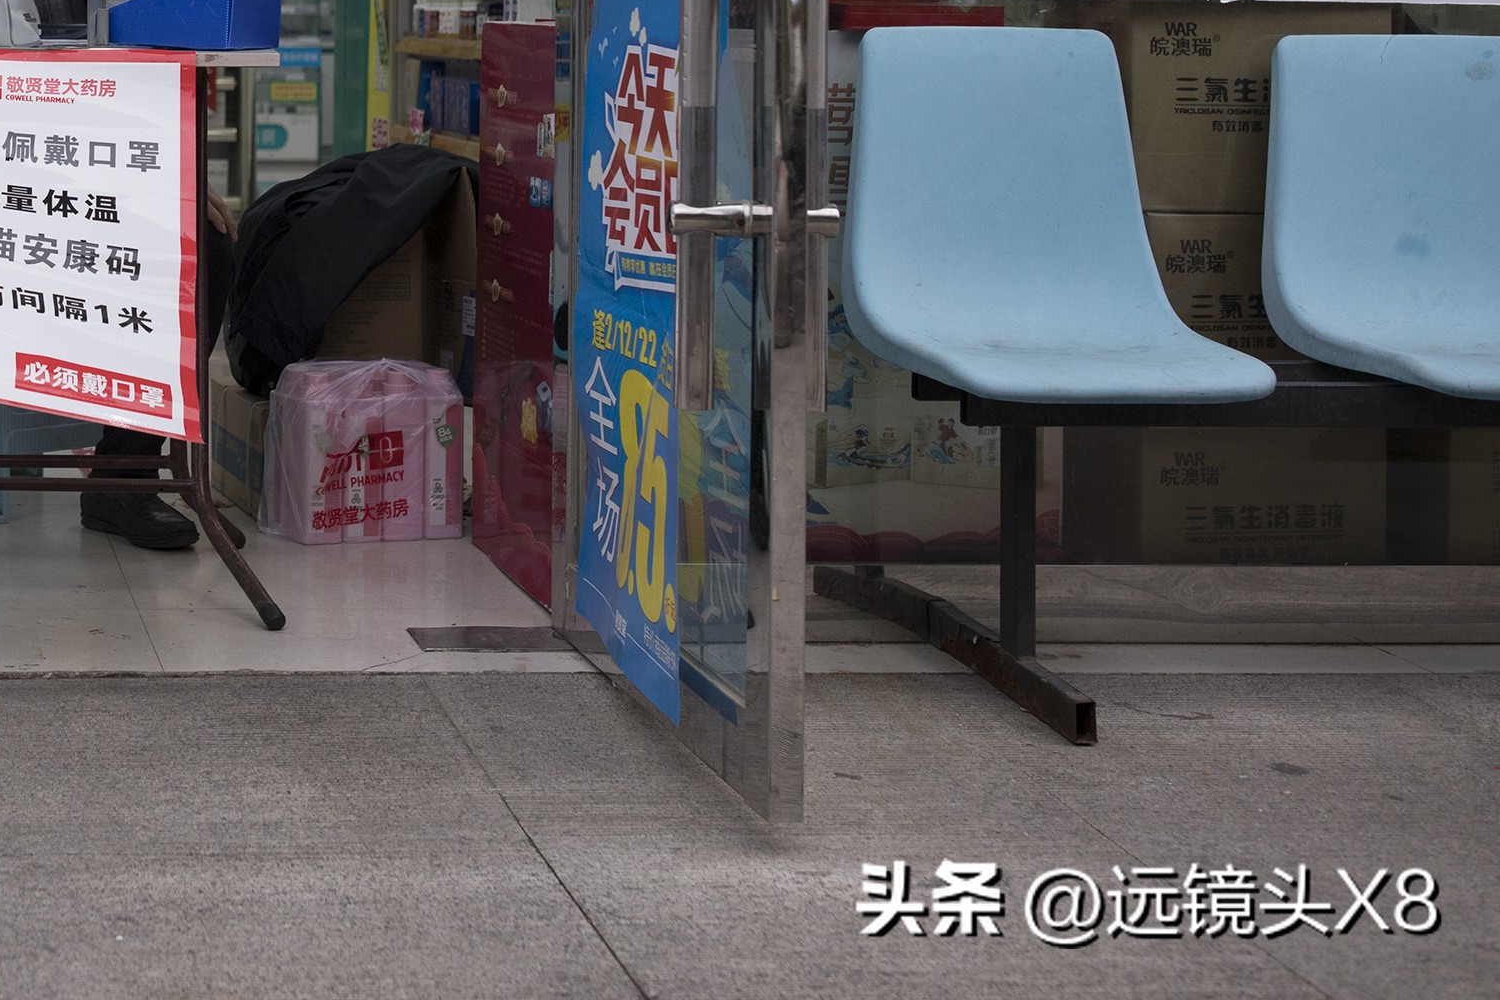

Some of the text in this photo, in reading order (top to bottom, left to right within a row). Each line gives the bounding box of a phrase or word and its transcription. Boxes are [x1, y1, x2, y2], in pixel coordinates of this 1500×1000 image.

[1164, 22, 1198, 37] WAR
[1150, 37, 1213, 57] 皖澳瑞
[6, 74, 117, 99] 敬贤堂大药房
[36, 94, 76, 104] PHARMACY
[1174, 107, 1224, 116] TRICLOSAN
[1211, 119, 1264, 133] 有效消毒
[1180, 239, 1213, 254] WAR
[1165, 254, 1227, 274] 皖澳瑞
[23, 360, 167, 410] 必须戴口罩
[584, 355, 620, 564] 全场
[1175, 451, 1206, 466] WAR
[350, 469, 405, 488] PHARMACY
[311, 498, 409, 531] 敬贤堂大药房
[1185, 503, 1346, 530] 三氯生消毒液
